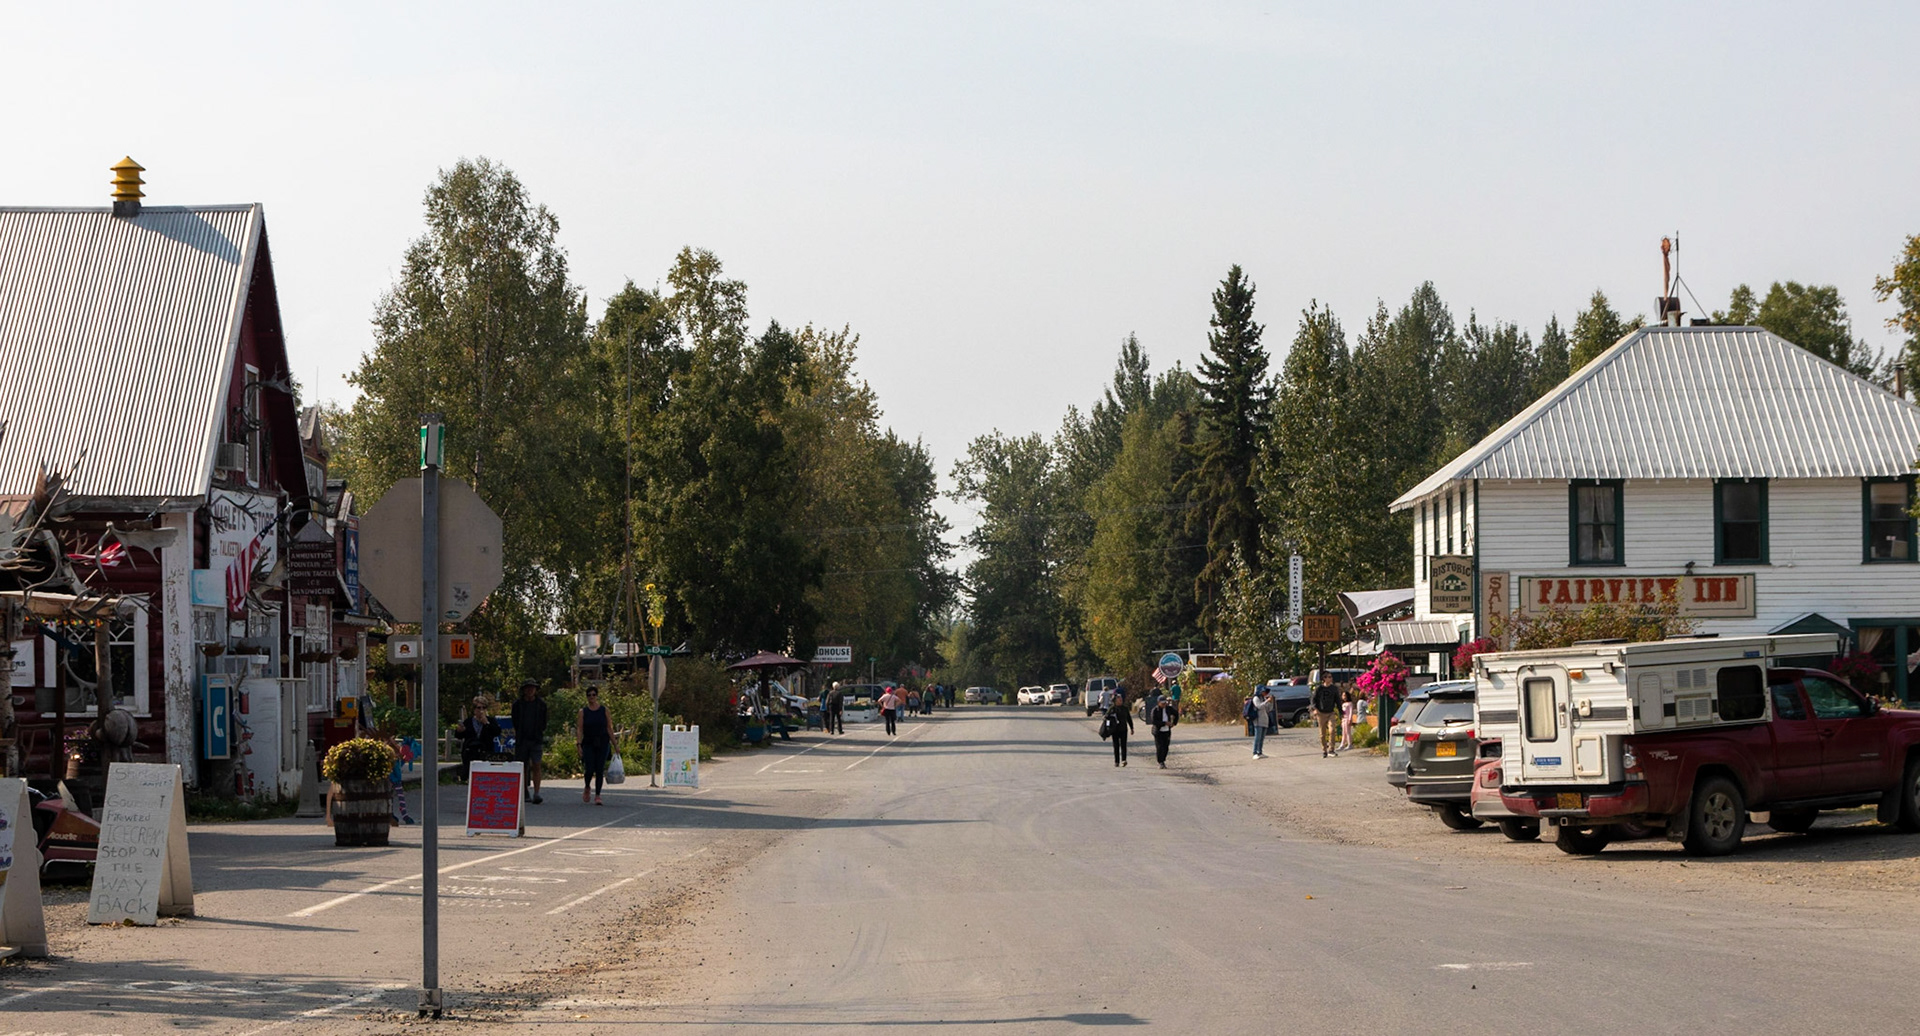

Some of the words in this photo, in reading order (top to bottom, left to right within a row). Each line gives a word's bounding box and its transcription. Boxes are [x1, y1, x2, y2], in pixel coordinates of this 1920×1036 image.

[291, 552, 333, 560] AMMUNITION
[1432, 562, 1471, 577] HISTORIC
[292, 587, 335, 595] SANDWICHES
[1537, 577, 1680, 604] FAIRVIEW
[1692, 577, 1739, 602] INN
[1308, 618, 1335, 629] DENALI
[1309, 630, 1334, 639] BREWPUB
[454, 643, 466, 655] 16
[142, 847, 160, 858] ON
[112, 862, 143, 873] THE
[101, 876, 148, 896] WAY
[97, 894, 153, 914] BACK
